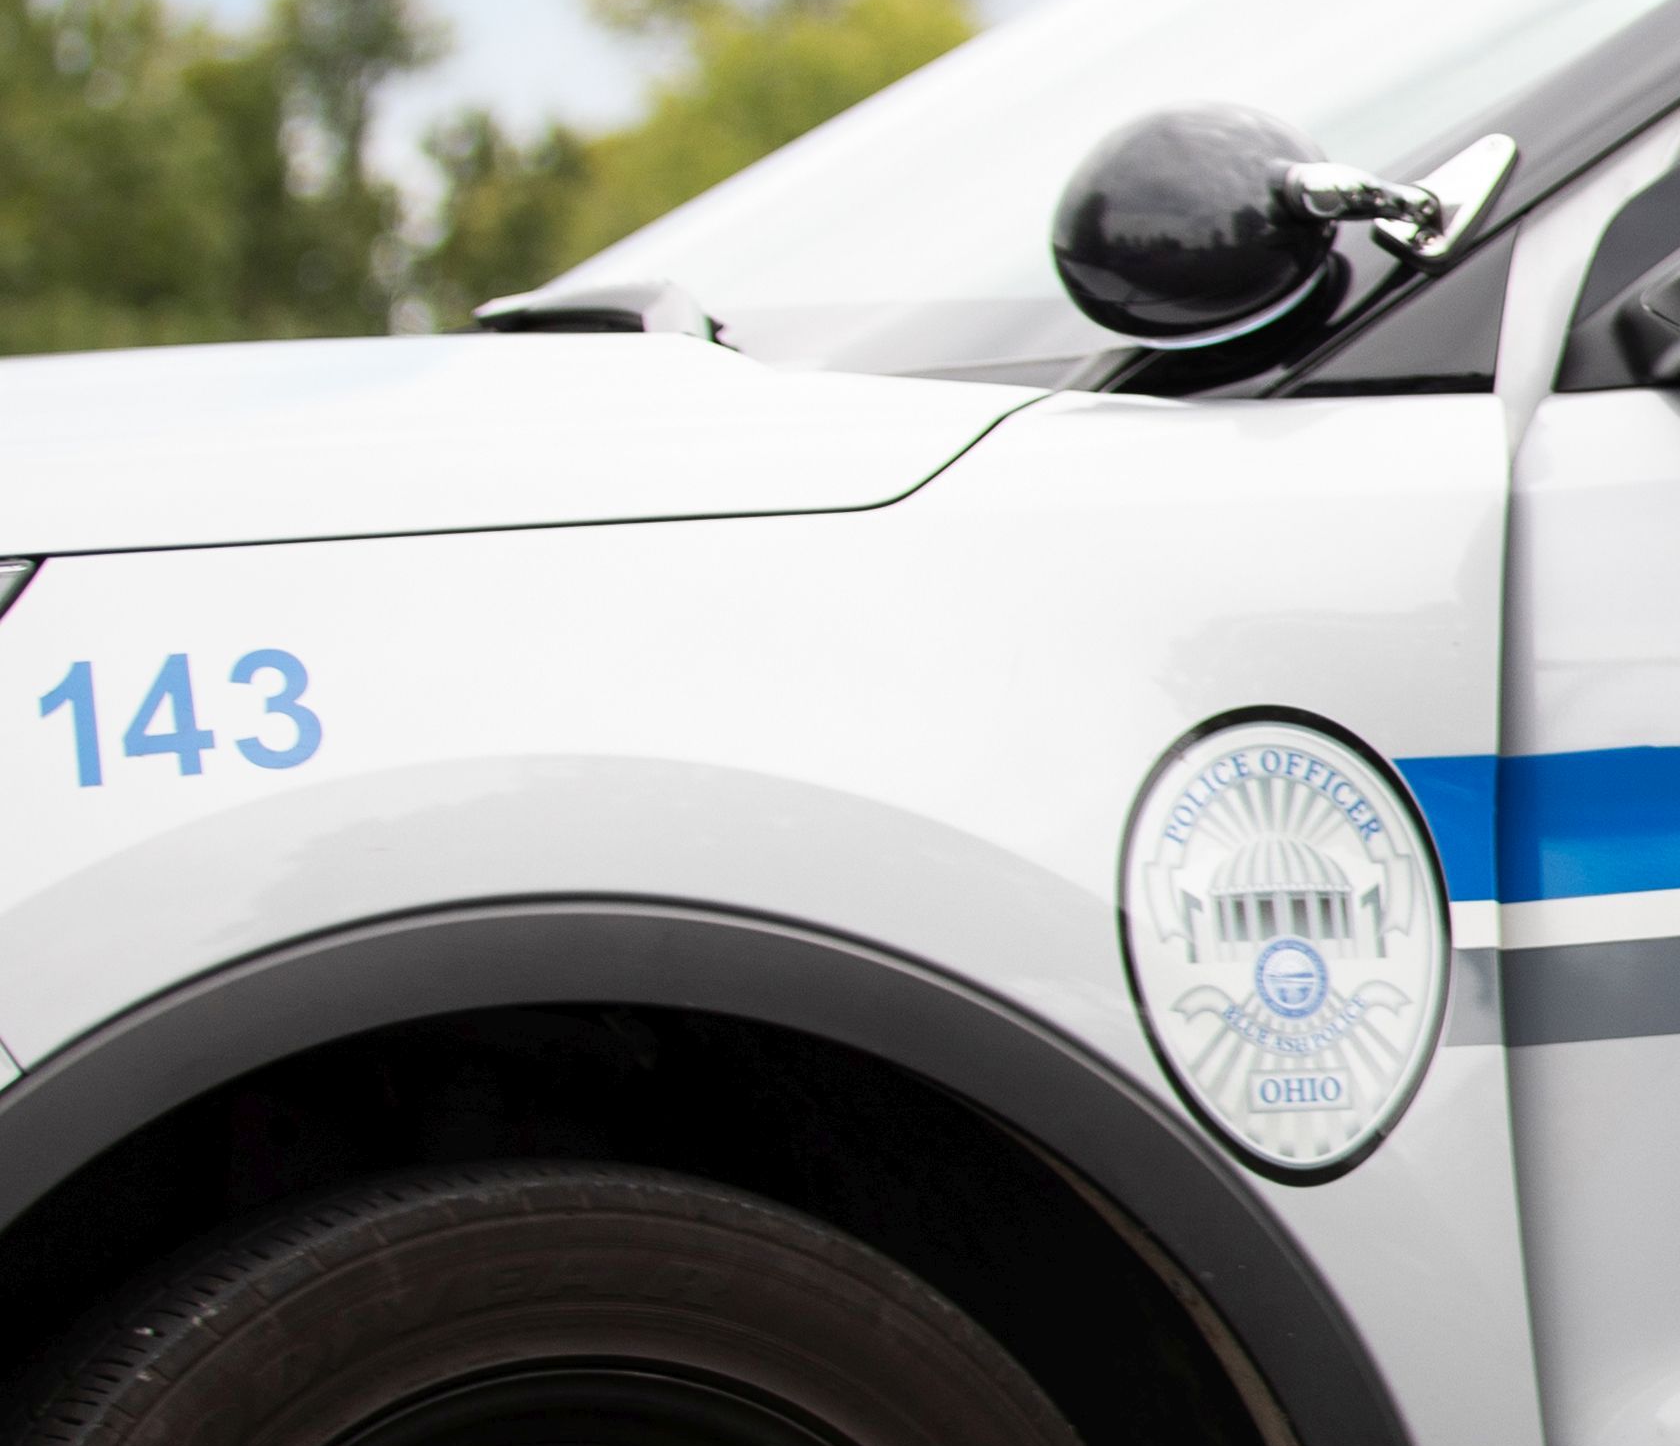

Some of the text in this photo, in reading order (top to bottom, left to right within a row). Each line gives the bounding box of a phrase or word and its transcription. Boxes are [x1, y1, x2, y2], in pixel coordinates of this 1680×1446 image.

[39, 648, 323, 787] 143
[1164, 750, 1383, 844] POLICE OFFICER
[1223, 1005, 1269, 1045] BLUE
[1312, 995, 1366, 1047] POLICE
[1259, 1076, 1342, 1104] OHIO
